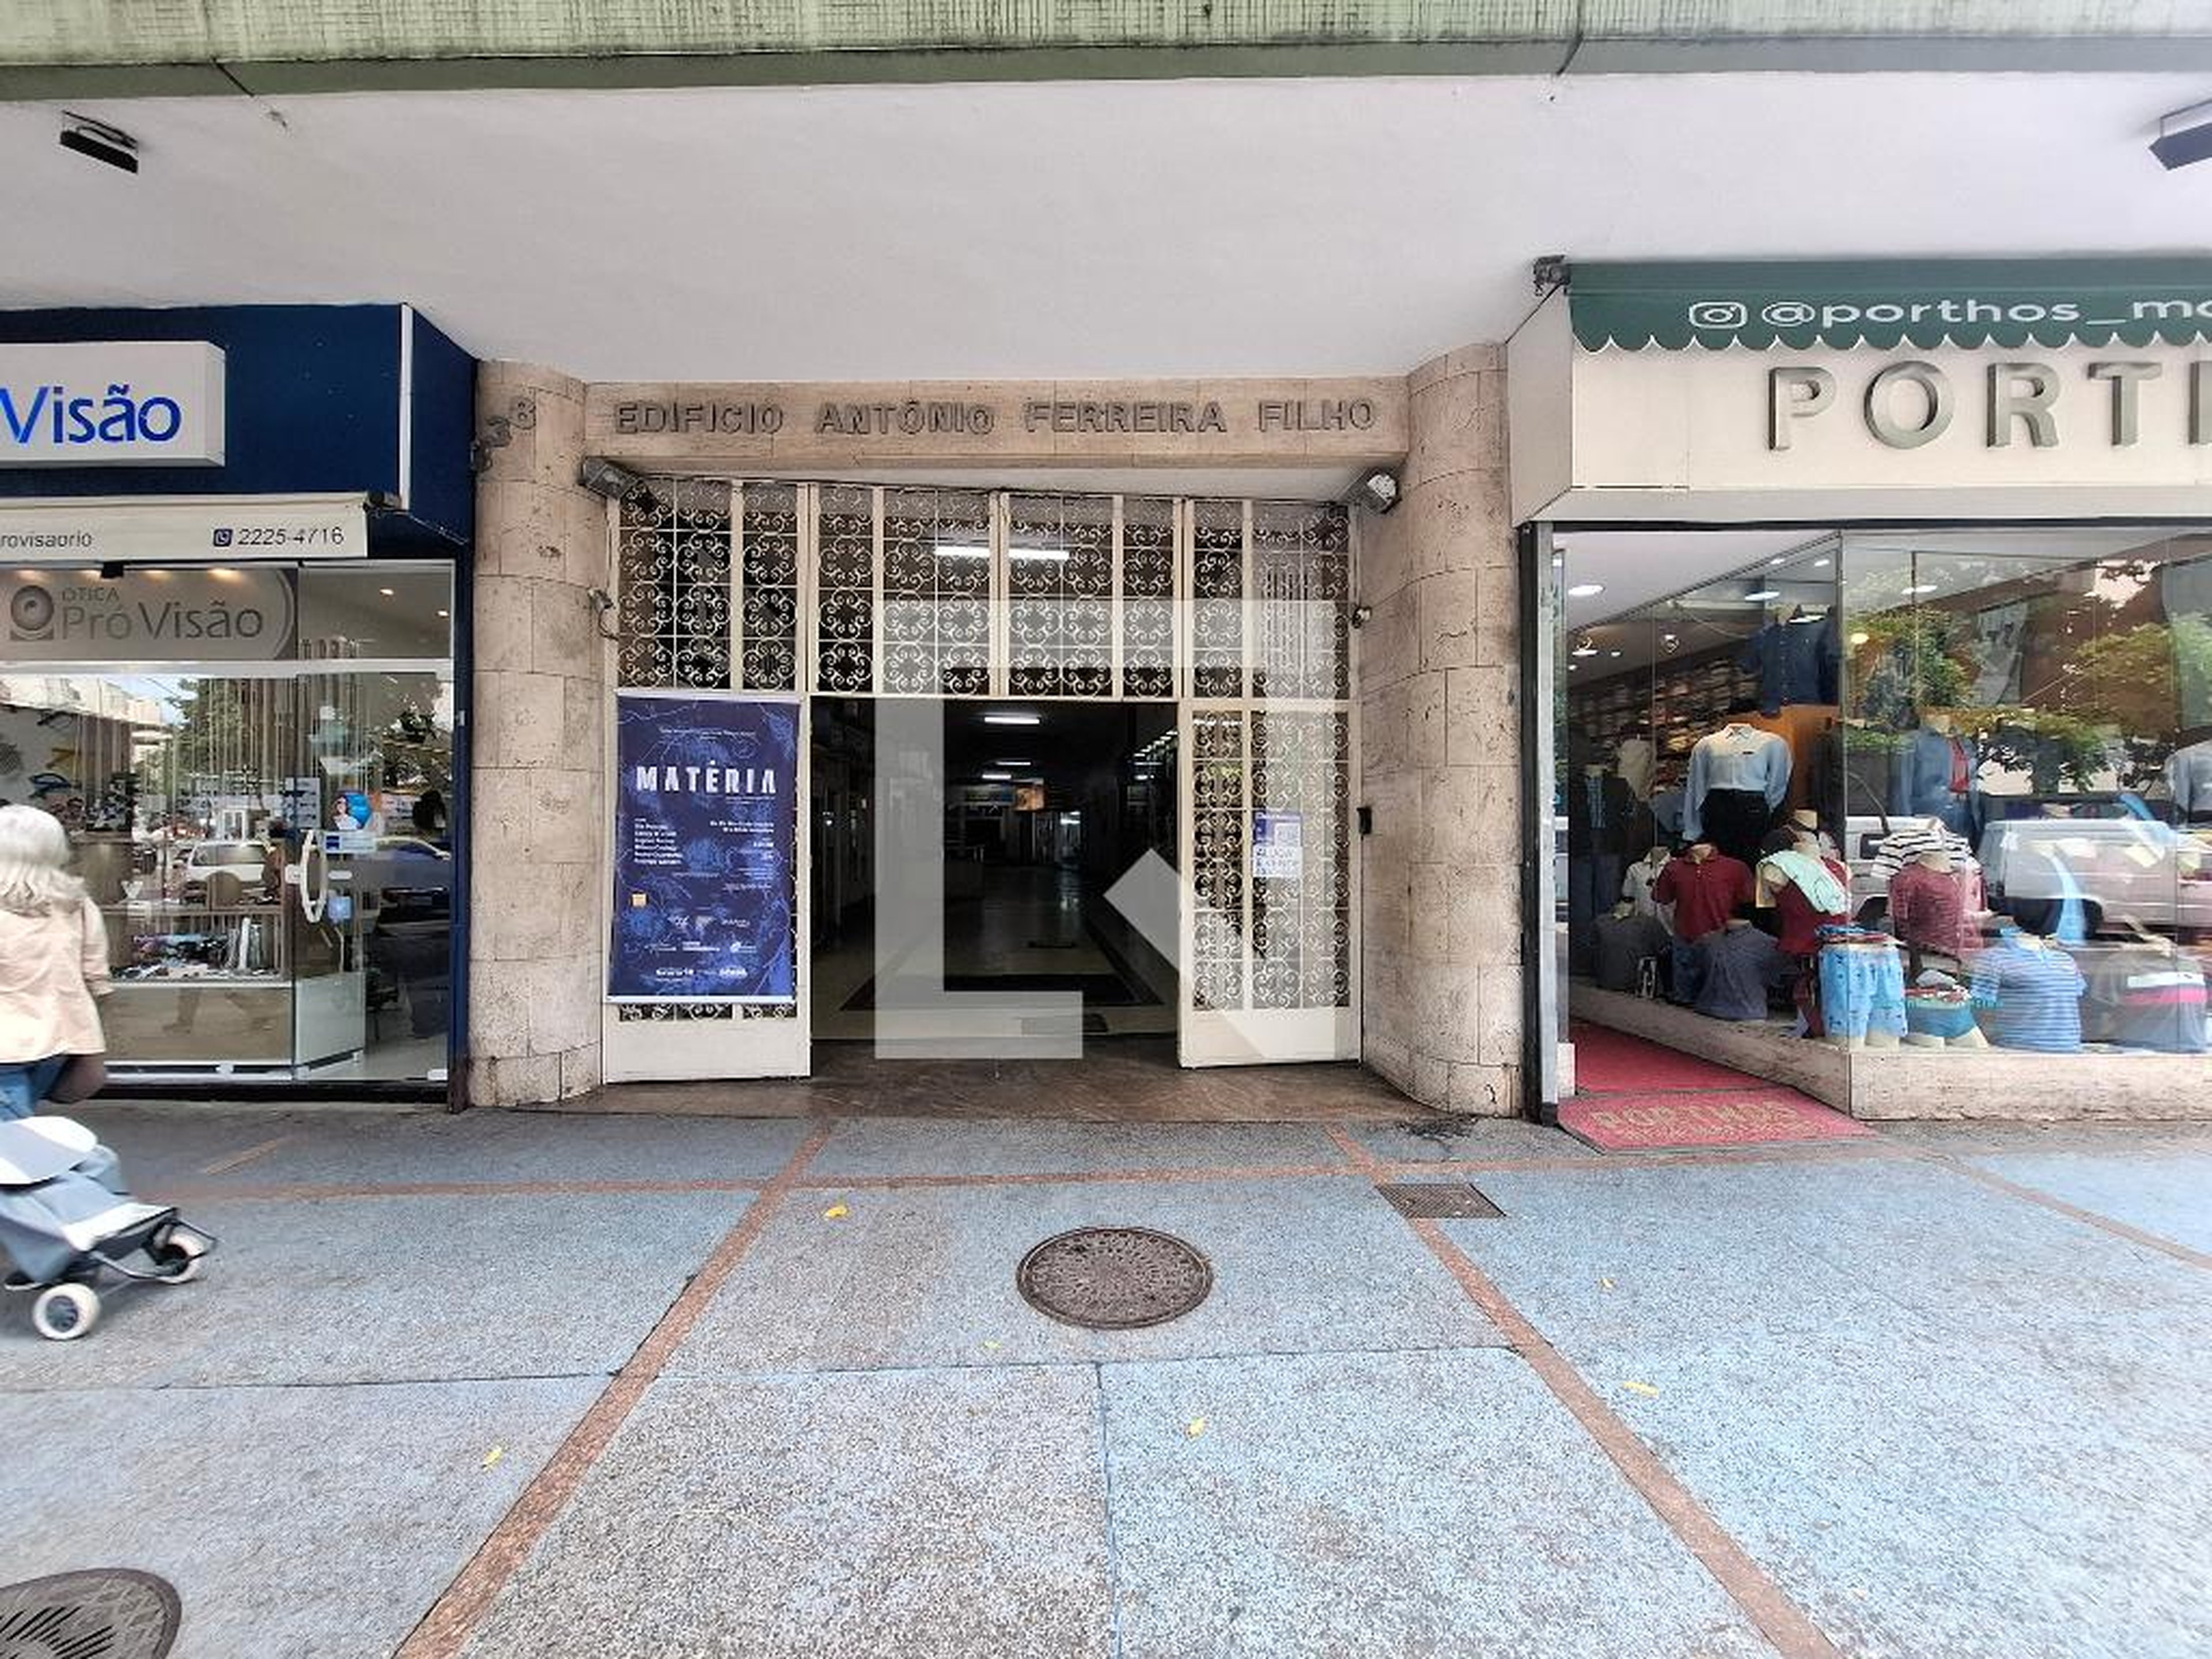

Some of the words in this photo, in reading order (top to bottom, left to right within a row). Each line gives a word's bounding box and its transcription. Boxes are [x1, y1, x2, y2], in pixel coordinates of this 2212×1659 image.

[0, 384, 181, 444] Visão
[614, 402, 784, 435] EDIFICIO
[1025, 400, 1228, 433] FERREIRA
[1258, 400, 1377, 431] FILHO
[237, 527, 344, 545] 2225-4716
[138, 600, 264, 639] Visão
[636, 759, 777, 794] MATÉRIA
